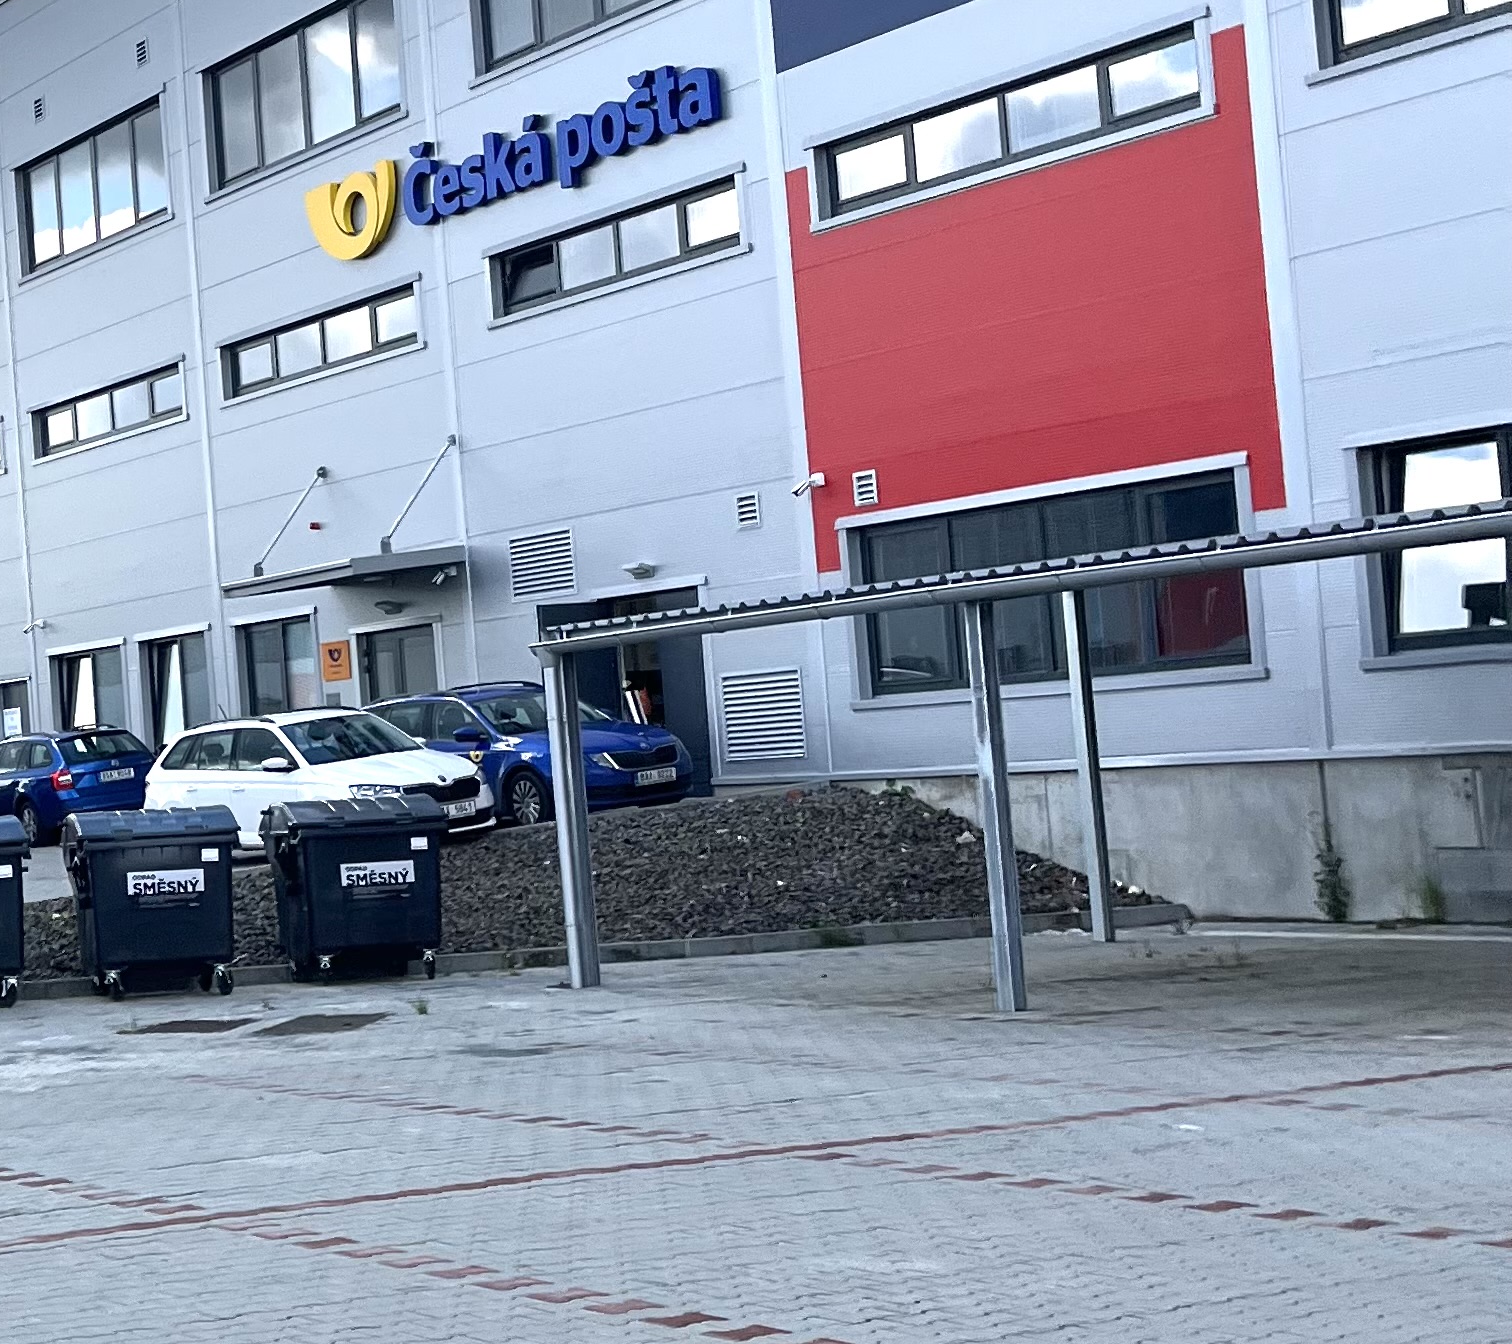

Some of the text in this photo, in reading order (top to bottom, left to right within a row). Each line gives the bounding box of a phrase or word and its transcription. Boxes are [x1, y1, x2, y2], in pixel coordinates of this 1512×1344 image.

[403, 65, 721, 226] Česká pošta
[132, 876, 200, 897] SMĚSNÝ
[346, 867, 410, 889] SMĚSNÝ
